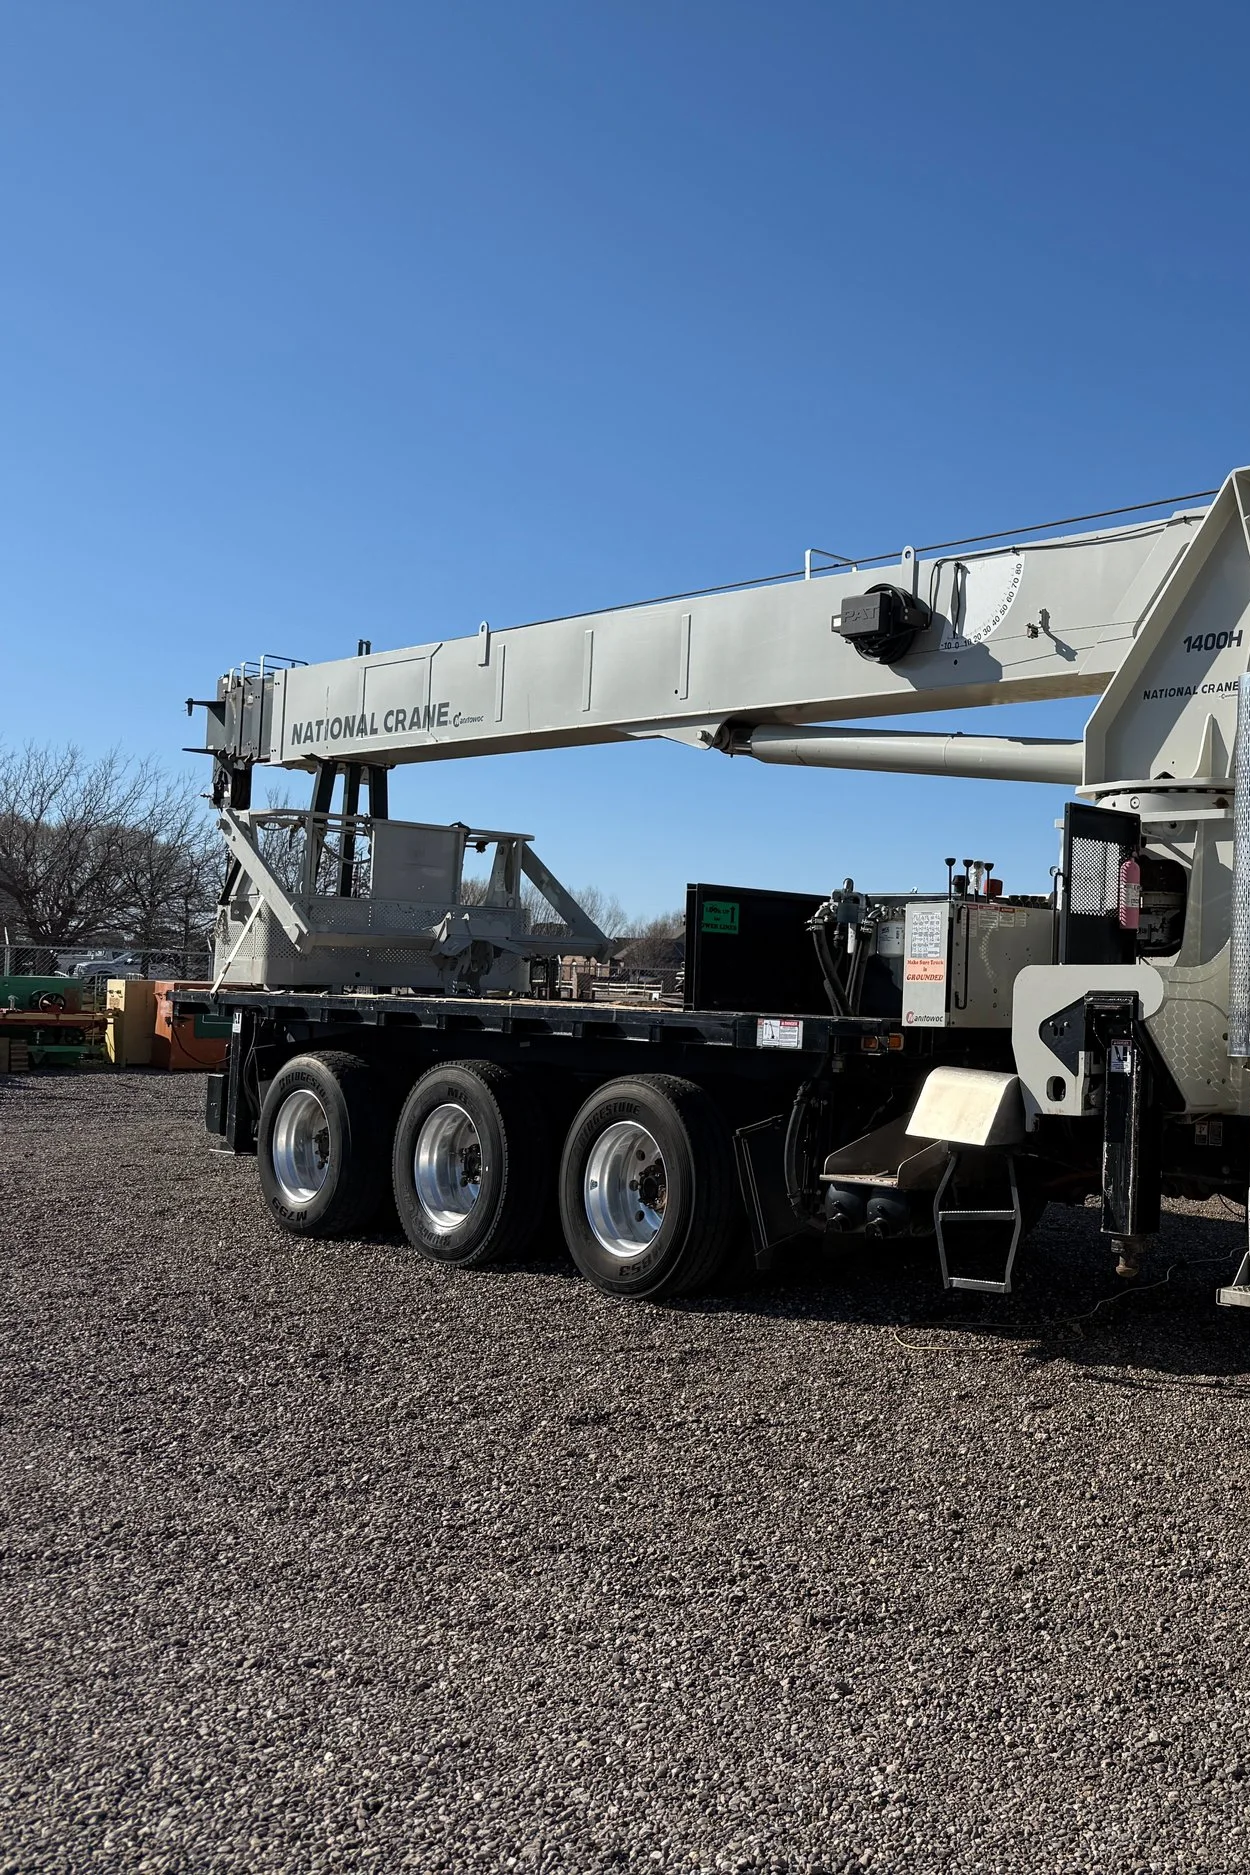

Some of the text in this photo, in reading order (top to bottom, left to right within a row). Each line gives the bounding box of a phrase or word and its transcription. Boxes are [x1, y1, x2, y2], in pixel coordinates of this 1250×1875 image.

[973, 633, 982, 643] 20
[982, 625, 992, 636] 30
[992, 615, 1001, 626] 40
[999, 604, 1008, 615] 50
[1006, 591, 1015, 603] 60
[1011, 577, 1020, 589] 70
[1016, 563, 1022, 575] 80
[1183, 629, 1243, 653] 1400H
[1143, 681, 1239, 700] NATIONAL CRANE
[291, 702, 450, 746] NATIONAL CRANE
[271, 1196, 307, 1222] M799
